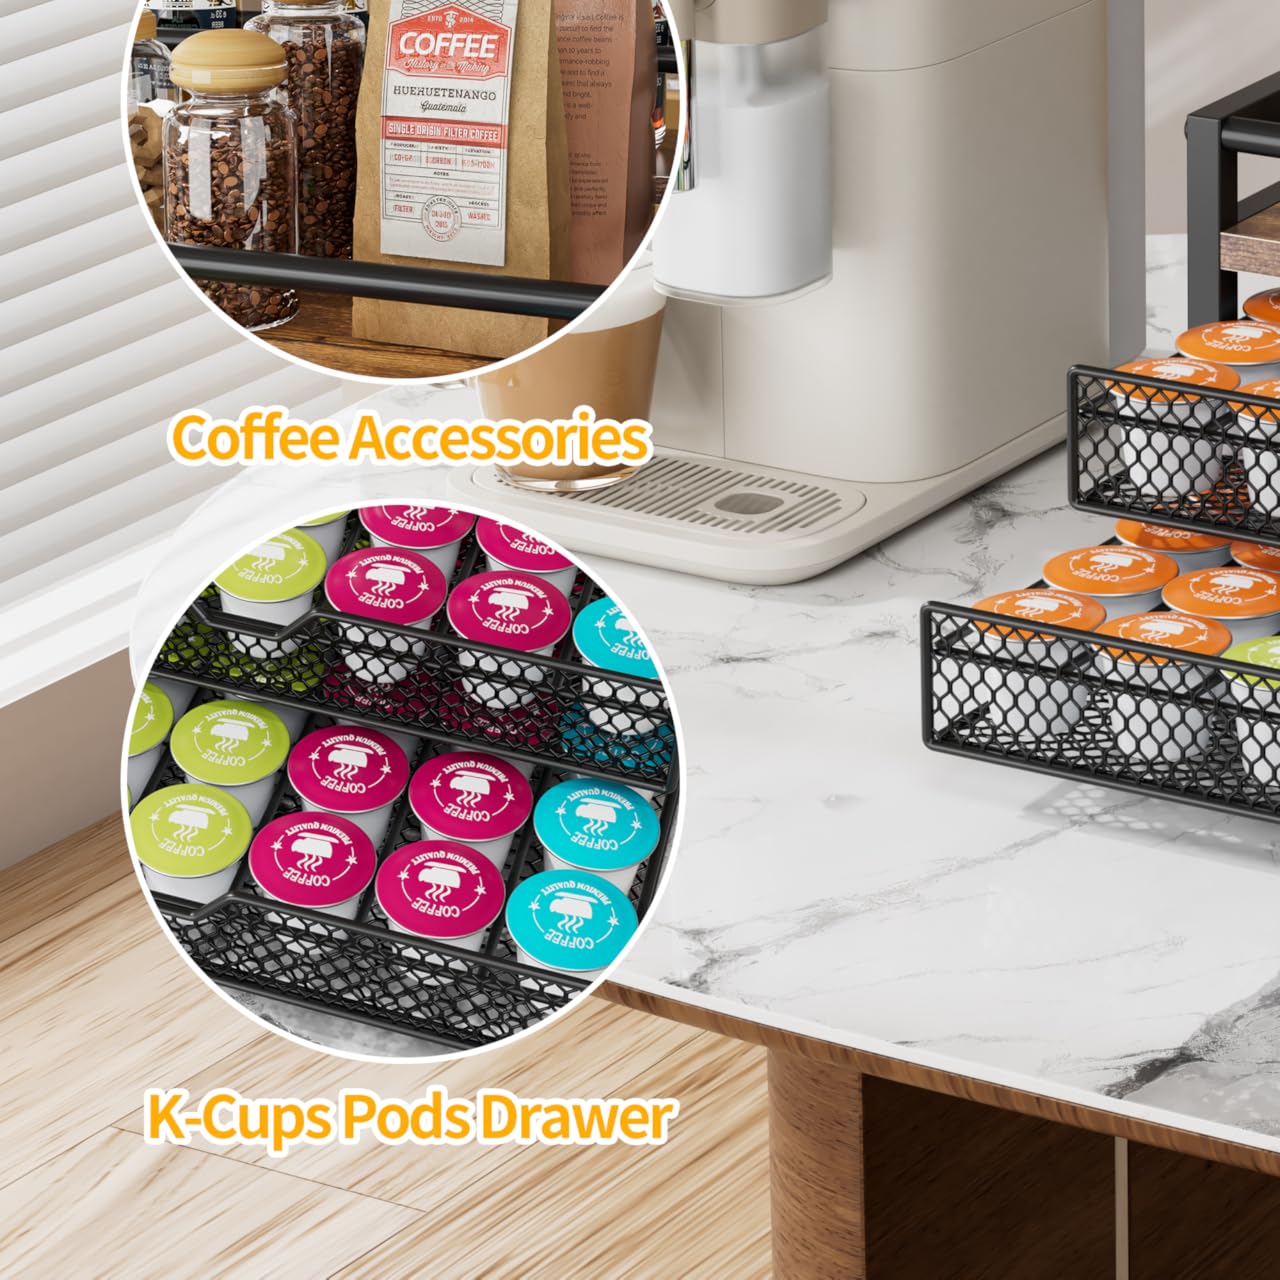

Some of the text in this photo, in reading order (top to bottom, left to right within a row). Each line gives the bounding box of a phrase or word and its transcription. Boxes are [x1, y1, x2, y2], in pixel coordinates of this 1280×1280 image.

[400, 32, 499, 58] COFFEE
[393, 85, 497, 101] HUEHUETENANGO
[420, 100, 467, 113] Guatemala
[388, 122, 498, 140] SINGLE ORIGIN FILTER COFFEE
[1205, 339, 1252, 353] COFFEE
[391, 516, 436, 533] COFFEE
[1143, 524, 1191, 539] COFFEE
[510, 538, 555, 556] COFFEE
[358, 553, 424, 574] PREMIUM QUALITY
[238, 567, 283, 584] COFFEE
[1070, 568, 1119, 582] COFFEE
[481, 578, 547, 599] PREMIUM QUALITY
[1193, 589, 1242, 605] COFFEE
[358, 591, 404, 609] COFFEE
[482, 616, 530, 635] COFFEE
[610, 643, 649, 660] OFFEE
[322, 734, 387, 756] PREMIUM QUALITY
[201, 749, 246, 767] COFFEE
[442, 760, 509, 783] PREMIUM QUALITY
[320, 775, 367, 795] COFFEE
[567, 788, 635, 811] PREMIUM QUALITY
[443, 803, 490, 822] COFFEE
[285, 821, 353, 846] PREMIUM QUALITY
[570, 831, 619, 851] COFFEE
[159, 838, 205, 857] COFFEE
[411, 850, 480, 875] PREMIUM QUALITY
[282, 867, 331, 887] COFFEE
[541, 880, 612, 906] PREMIUM QUALITY
[411, 897, 461, 918] COFFEE
[544, 928, 595, 950] COFFEE
